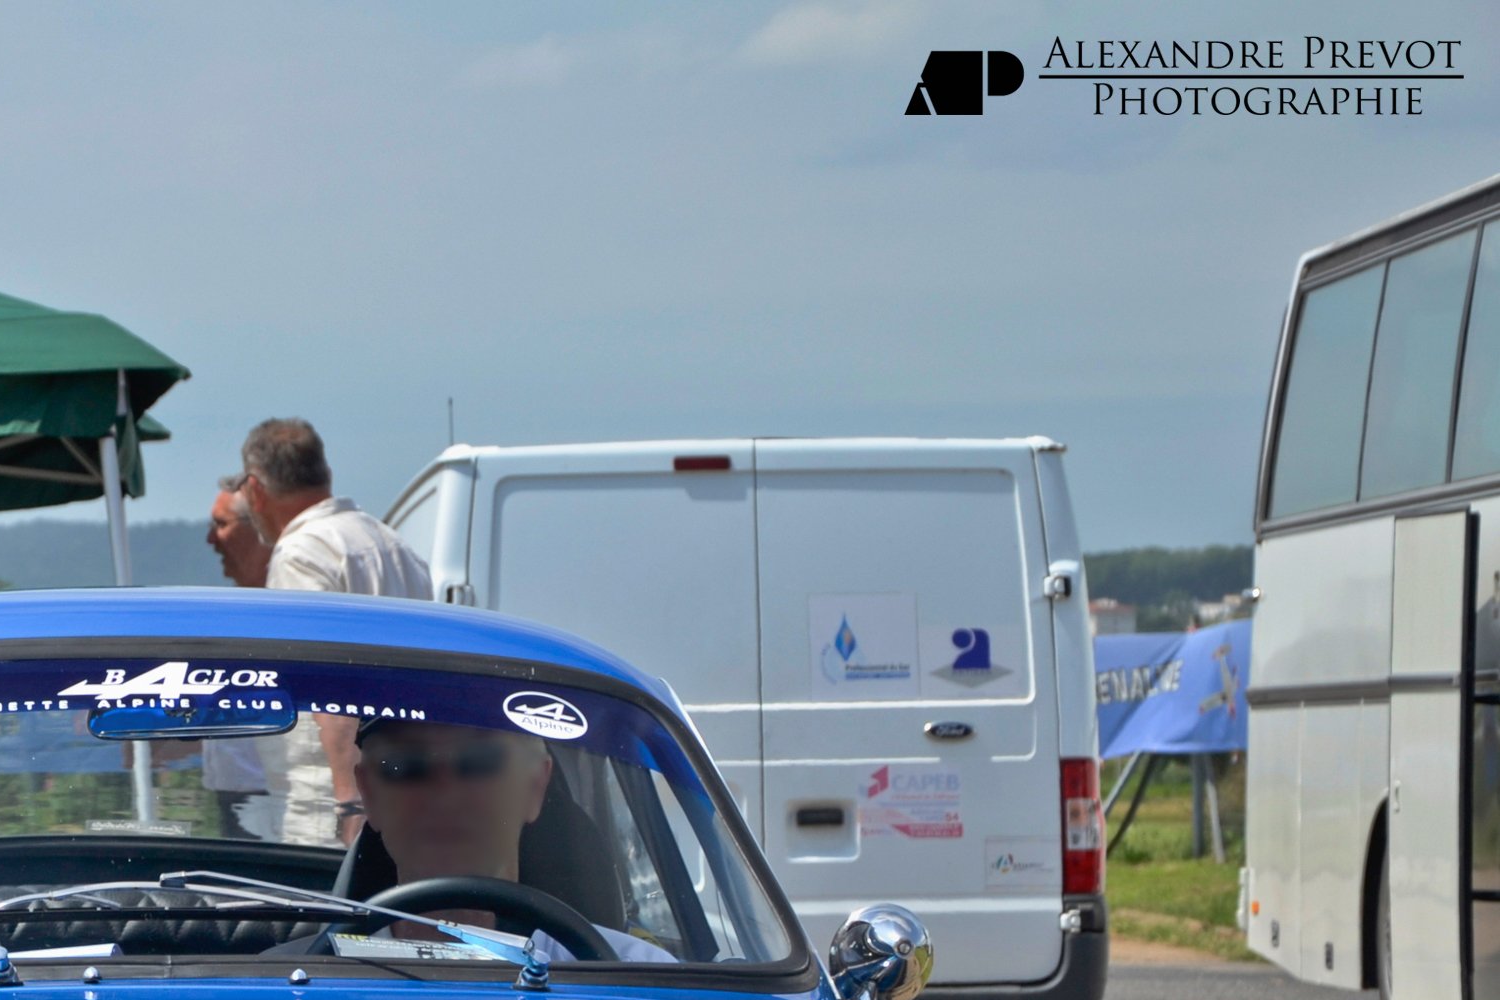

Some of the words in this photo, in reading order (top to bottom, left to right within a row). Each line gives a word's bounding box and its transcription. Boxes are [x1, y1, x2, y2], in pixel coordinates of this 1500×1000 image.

[97, 699, 191, 710] ALPINE
[218, 699, 283, 710] CLUB
[311, 702, 425, 720] LORRAIN
[521, 717, 574, 734] Alpine
[891, 773, 961, 792] CAPEB
